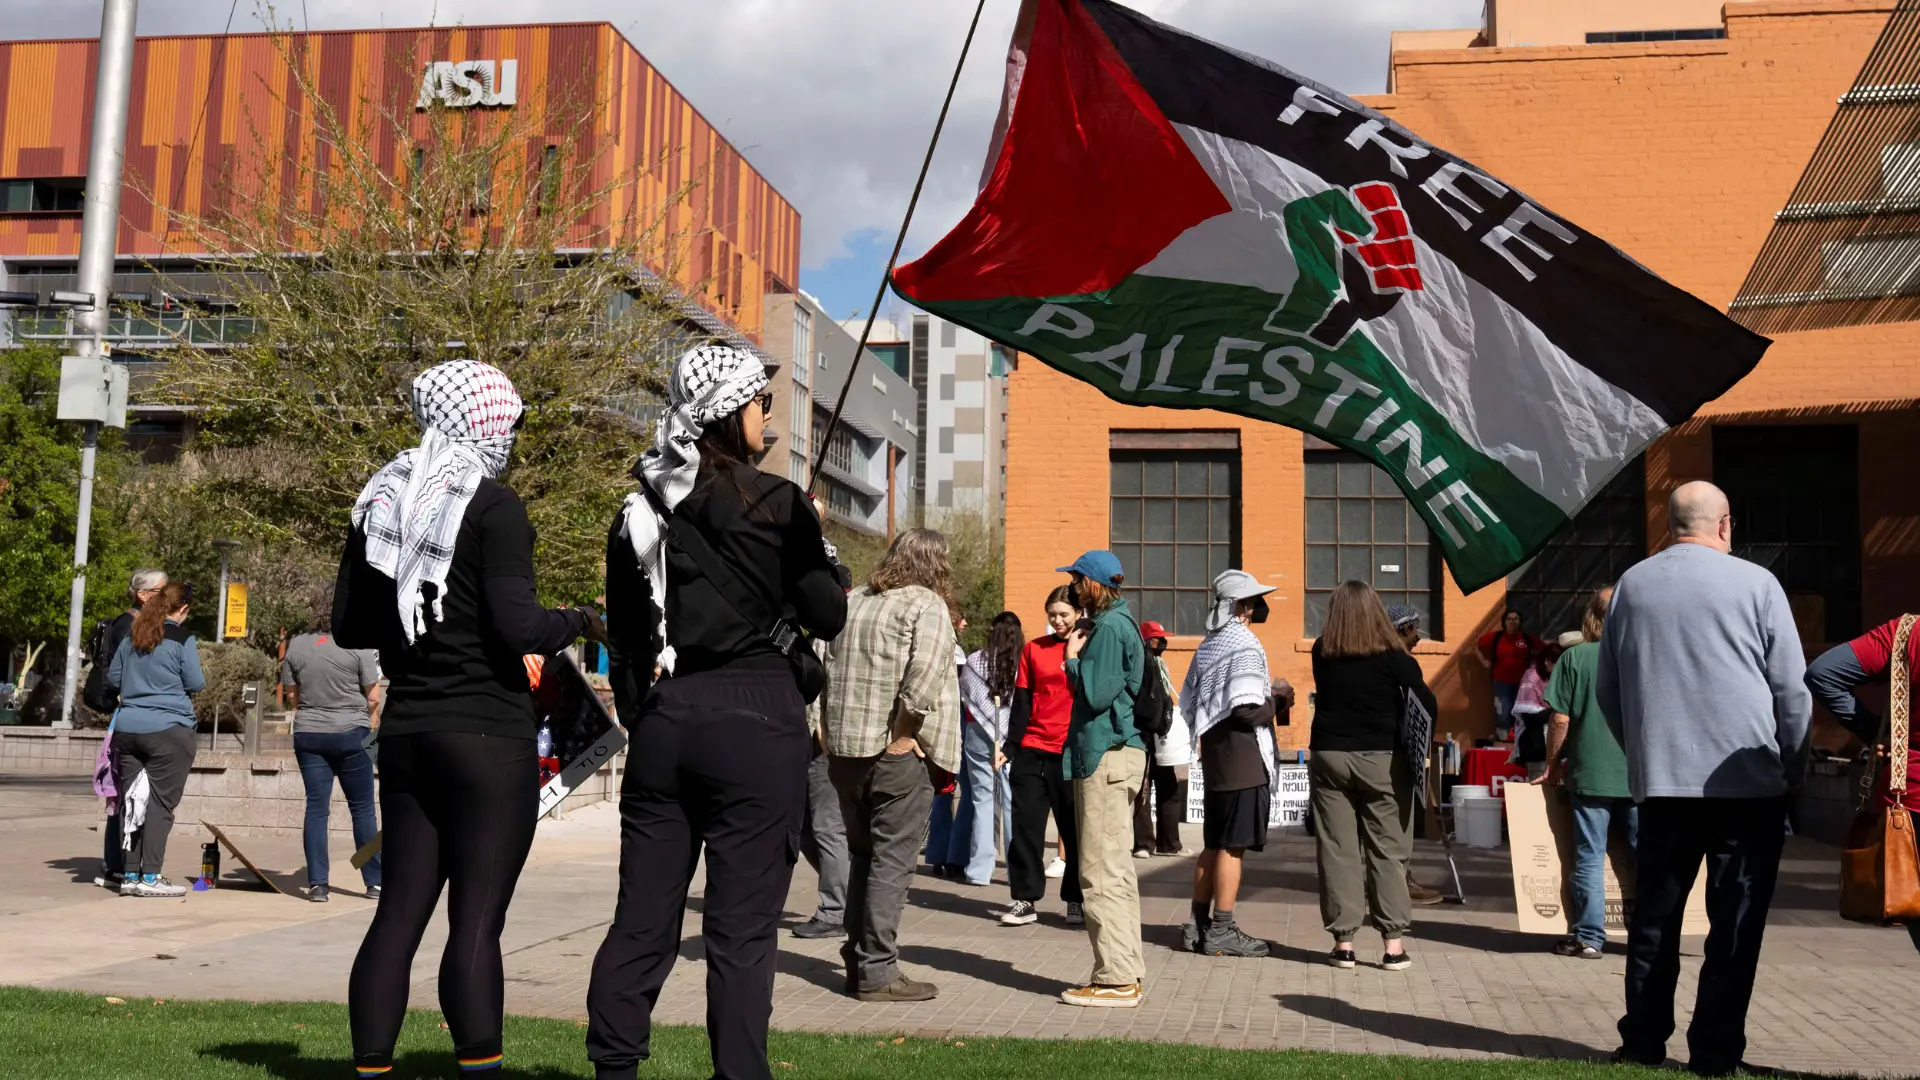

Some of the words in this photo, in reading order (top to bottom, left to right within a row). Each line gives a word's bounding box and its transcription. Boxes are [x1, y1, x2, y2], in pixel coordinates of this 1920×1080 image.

[416, 59, 517, 107] ASU
[1277, 86, 1579, 282] FREE
[1015, 303, 1500, 550] PALESTINE
